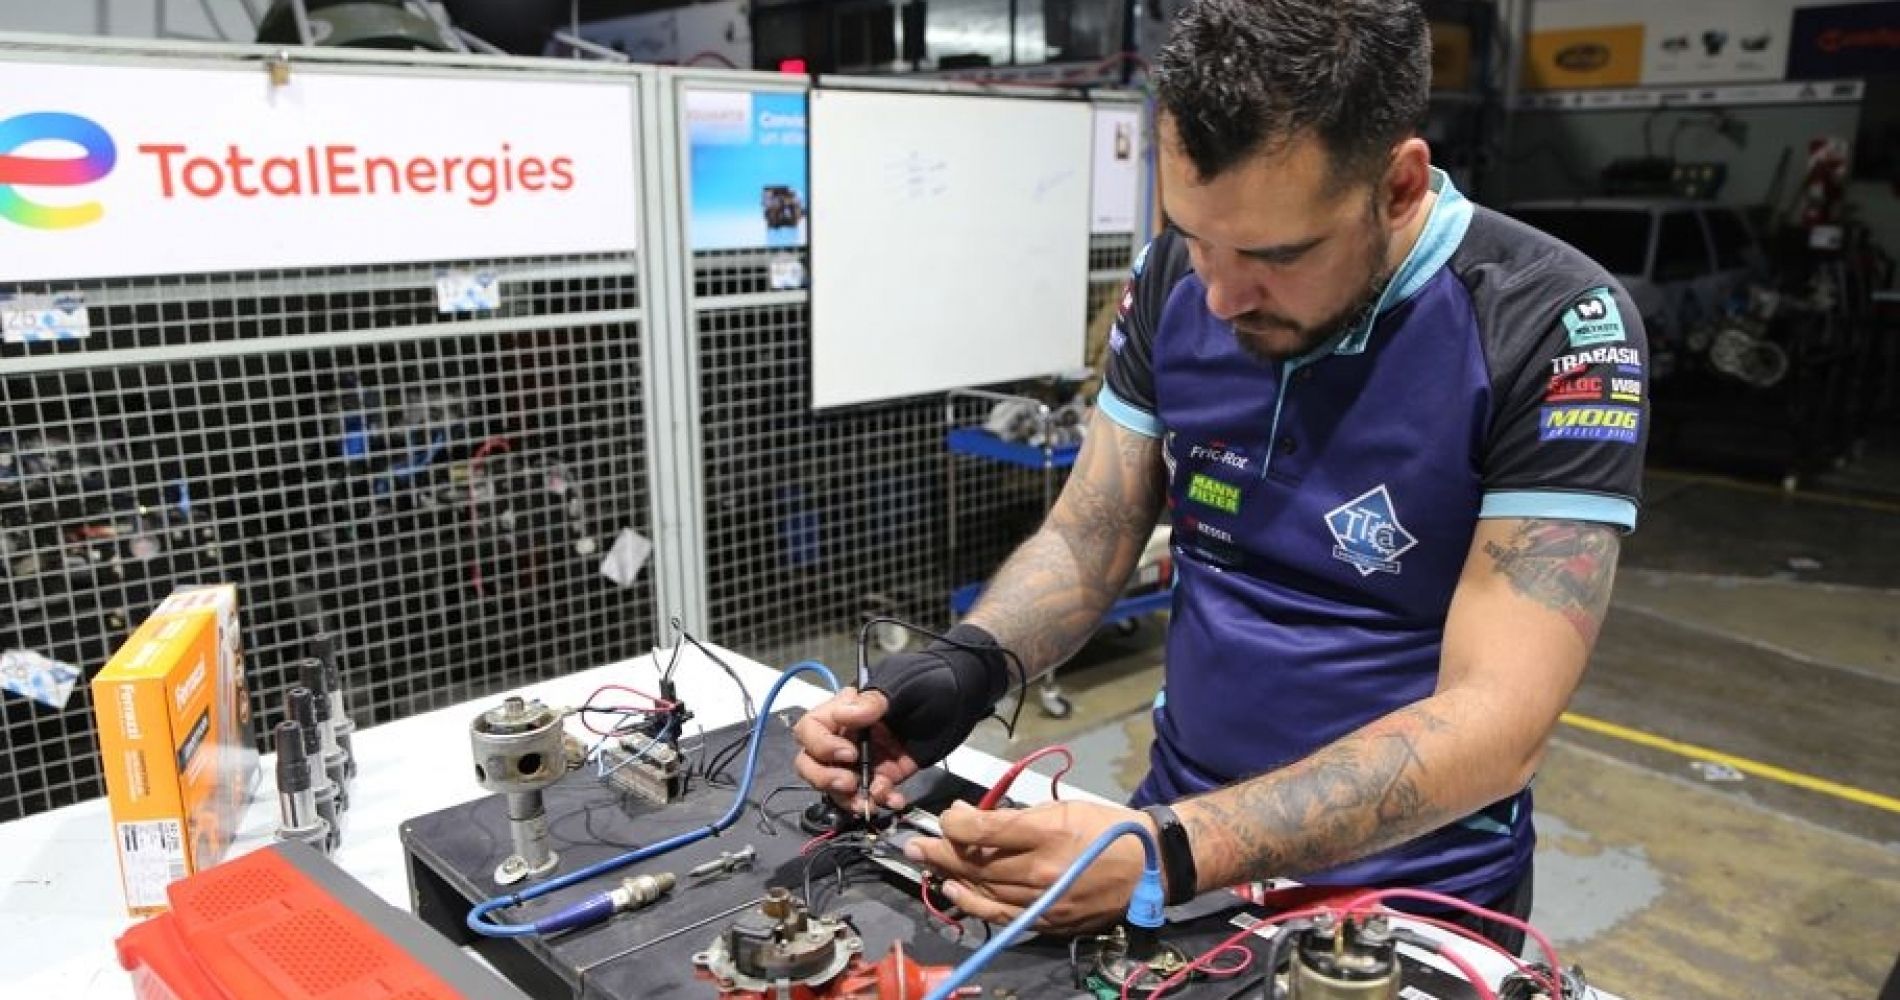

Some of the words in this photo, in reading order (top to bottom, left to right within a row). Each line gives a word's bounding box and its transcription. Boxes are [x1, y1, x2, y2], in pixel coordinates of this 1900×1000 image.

[138, 143, 575, 206] TotalEnergies
[1552, 347, 1641, 374] TRABASIL
[1547, 409, 1638, 429] MOOG
[1190, 445, 1248, 470] Fric-Rot
[1193, 475, 1240, 498] MANN
